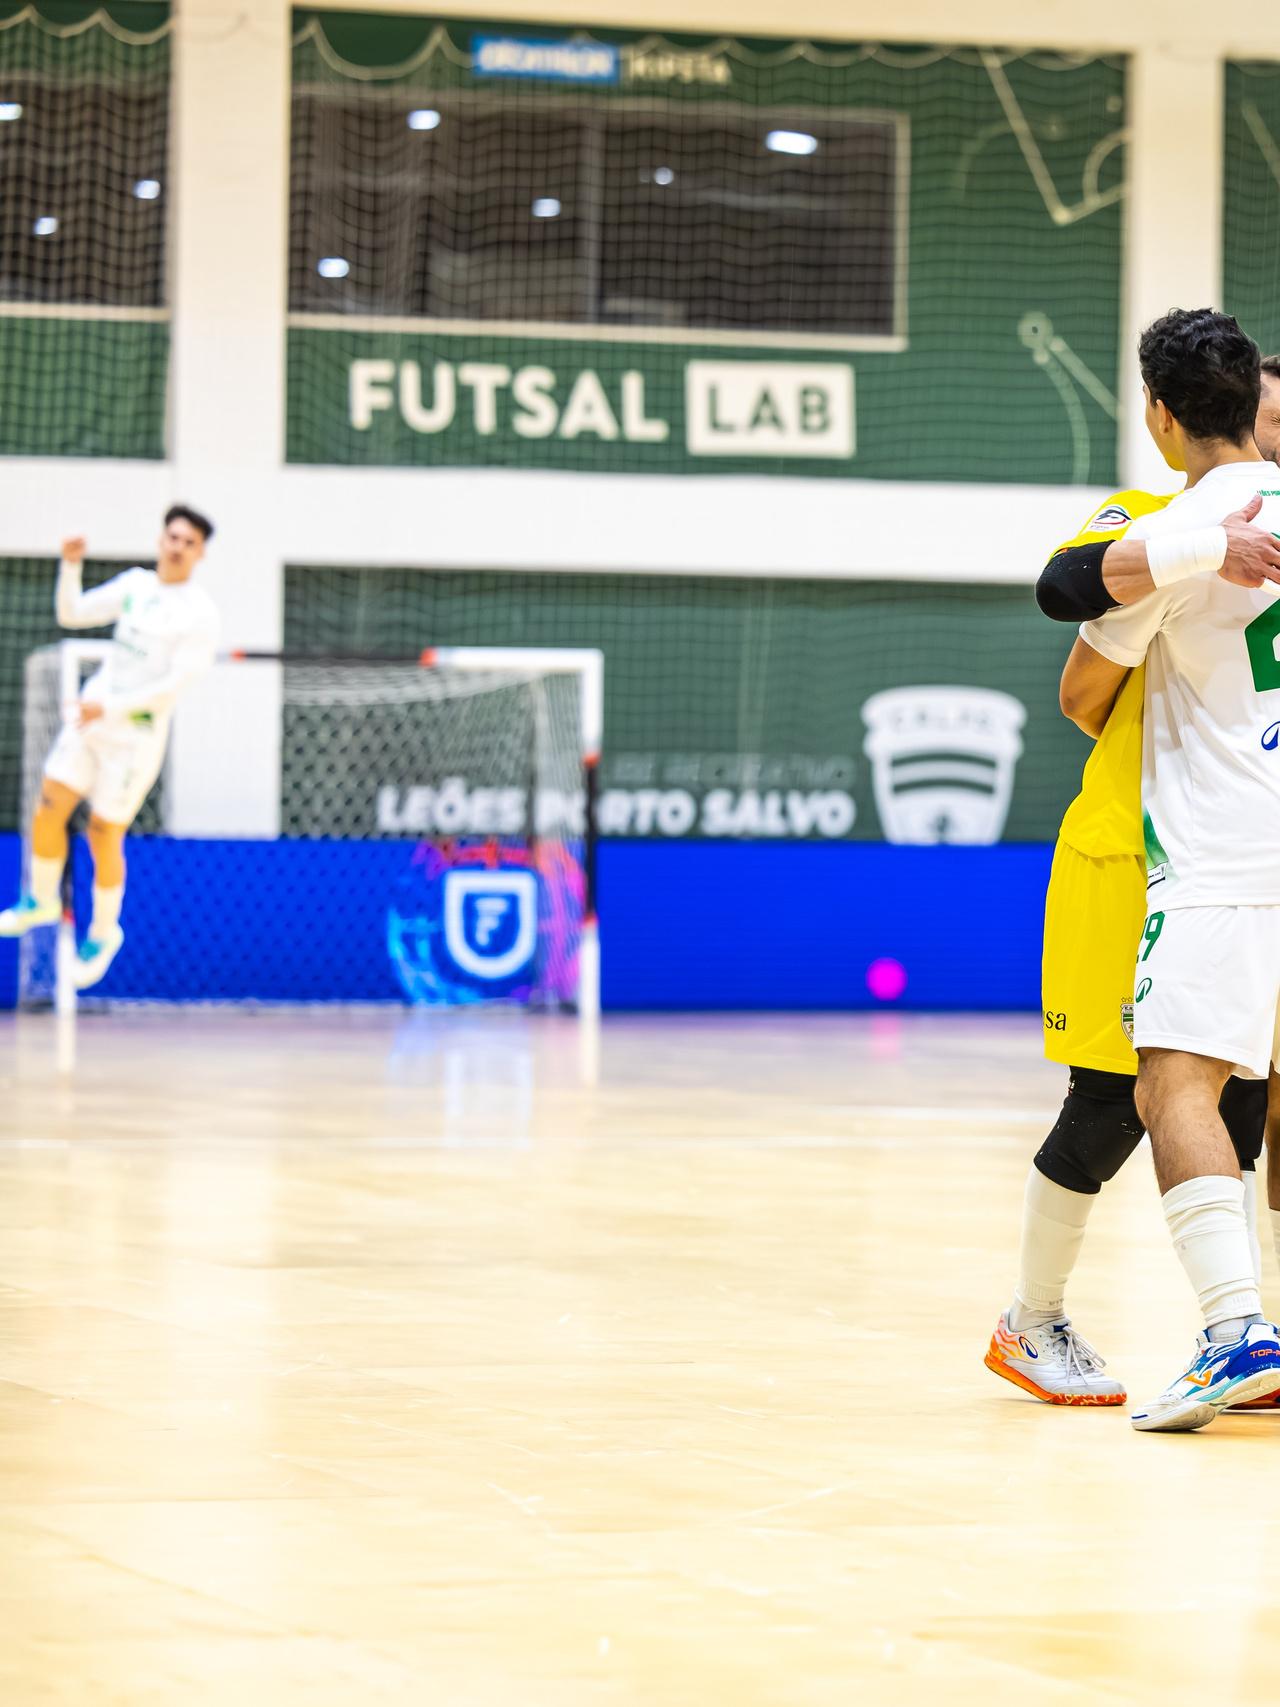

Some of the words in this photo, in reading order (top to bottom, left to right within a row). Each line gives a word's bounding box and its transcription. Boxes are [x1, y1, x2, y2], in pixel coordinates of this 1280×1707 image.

[348, 359, 669, 442] FUTSAL
[707, 381, 832, 435] LAB
[701, 787, 857, 838] SALVO
[1136, 911, 1166, 963] 9
